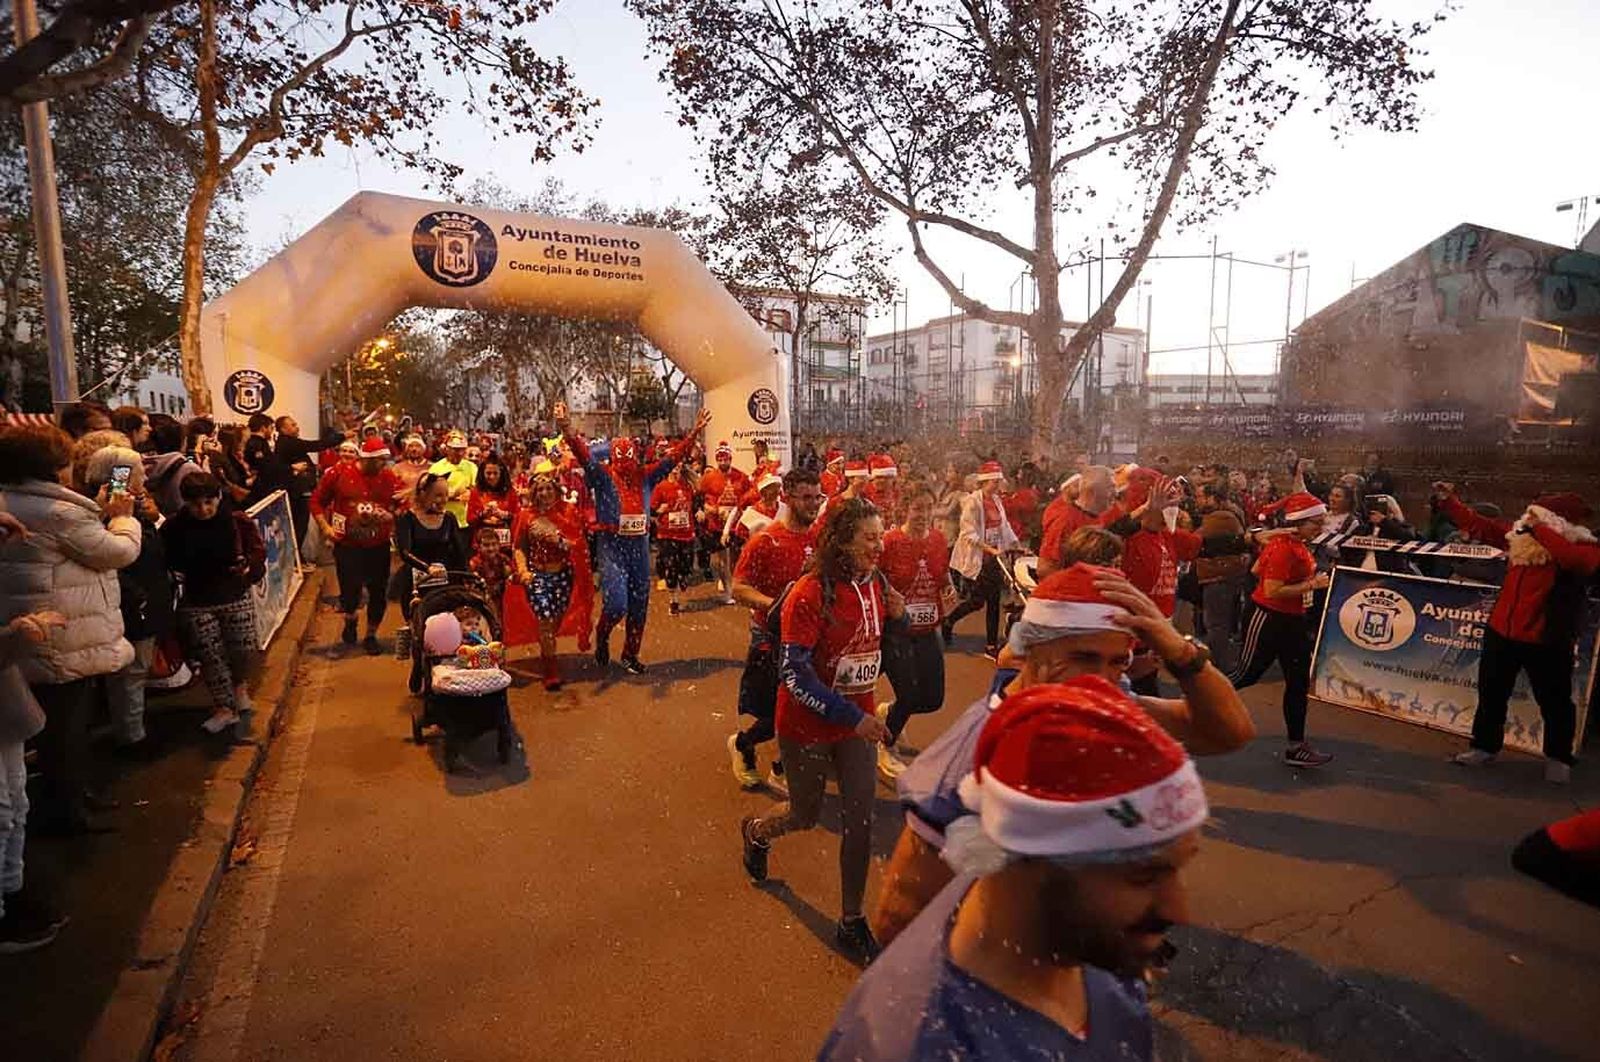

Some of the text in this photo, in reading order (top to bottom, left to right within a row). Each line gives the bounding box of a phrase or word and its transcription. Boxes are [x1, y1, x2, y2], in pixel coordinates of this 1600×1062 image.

[501, 224, 641, 250] Ayuntamiento
[543, 245, 641, 267] de Huelva
[575, 268, 589, 277] de
[593, 268, 644, 282] Deportes
[1403, 410, 1464, 422] HYUNDAI
[917, 611, 935, 623] 566
[1421, 602, 1491, 624] Ayunta
[1459, 622, 1485, 639] de
[855, 663, 877, 683] 409
